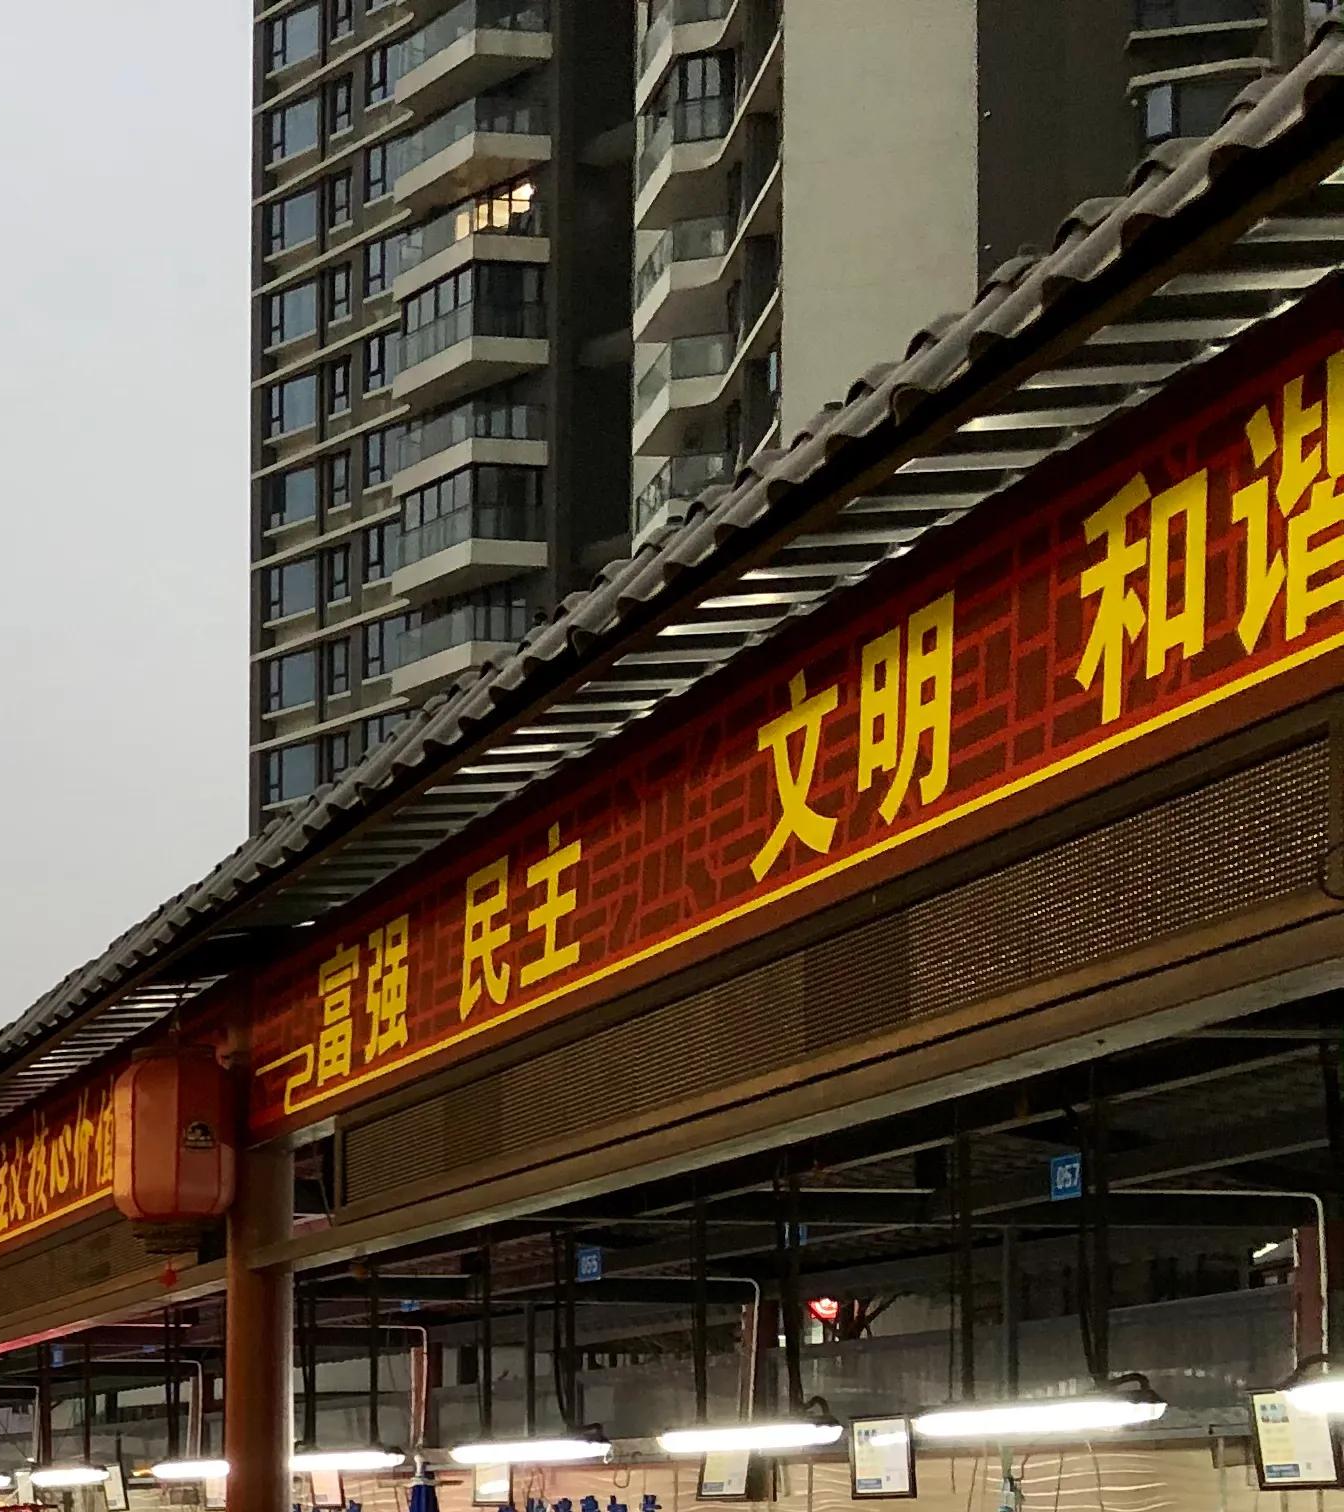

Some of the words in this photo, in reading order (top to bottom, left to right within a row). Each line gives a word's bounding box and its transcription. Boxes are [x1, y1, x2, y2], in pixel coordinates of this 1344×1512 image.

[316, 913, 409, 1088] 富强
[458, 824, 581, 1021] 民主
[749, 592, 955, 882] 文明
[1075, 349, 1344, 725] 和谐
